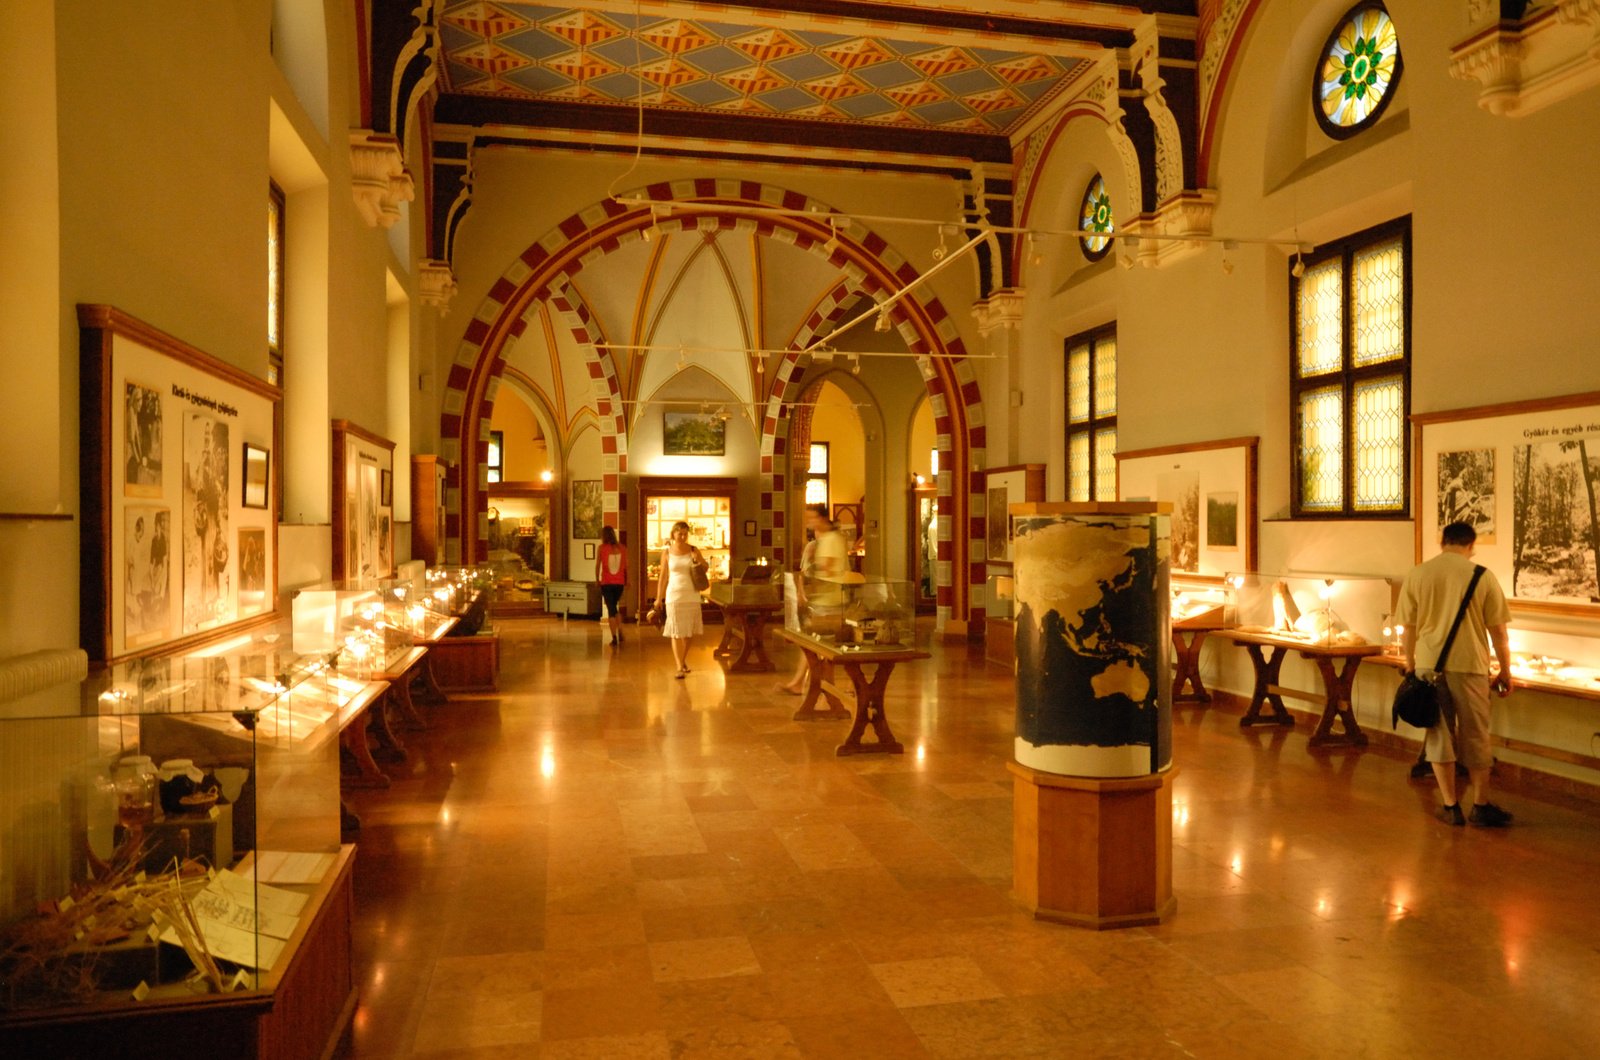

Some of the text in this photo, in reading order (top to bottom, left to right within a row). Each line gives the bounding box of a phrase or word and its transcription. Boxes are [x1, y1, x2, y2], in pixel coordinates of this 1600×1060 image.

[1523, 428, 1549, 439] Gyökér
[1551, 426, 1559, 435] és
[1562, 423, 1583, 436] egyéb
